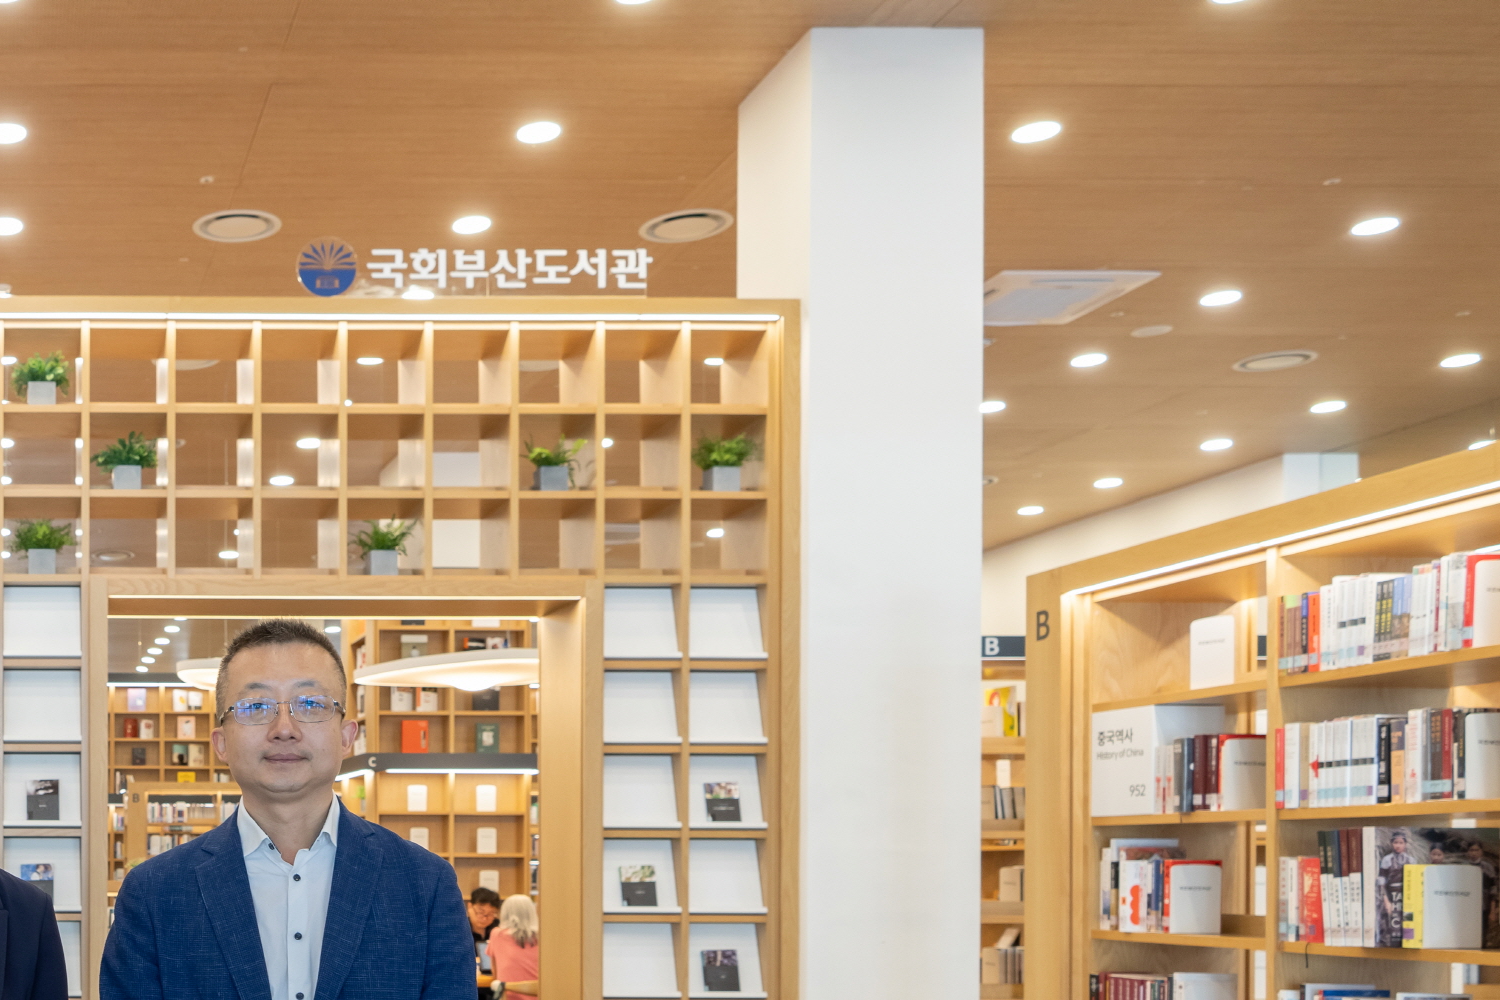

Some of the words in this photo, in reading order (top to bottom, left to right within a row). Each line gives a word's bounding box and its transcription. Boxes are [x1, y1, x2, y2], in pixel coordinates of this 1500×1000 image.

[366, 248, 653, 289] 국회부산도서관
[1036, 610, 1050, 641] B
[985, 637, 1000, 656] B
[1098, 727, 1133, 747] 중국역사
[368, 756, 377, 768] C
[1097, 751, 1118, 761] History
[1126, 747, 1145, 758] China
[1129, 784, 1146, 797] 952
